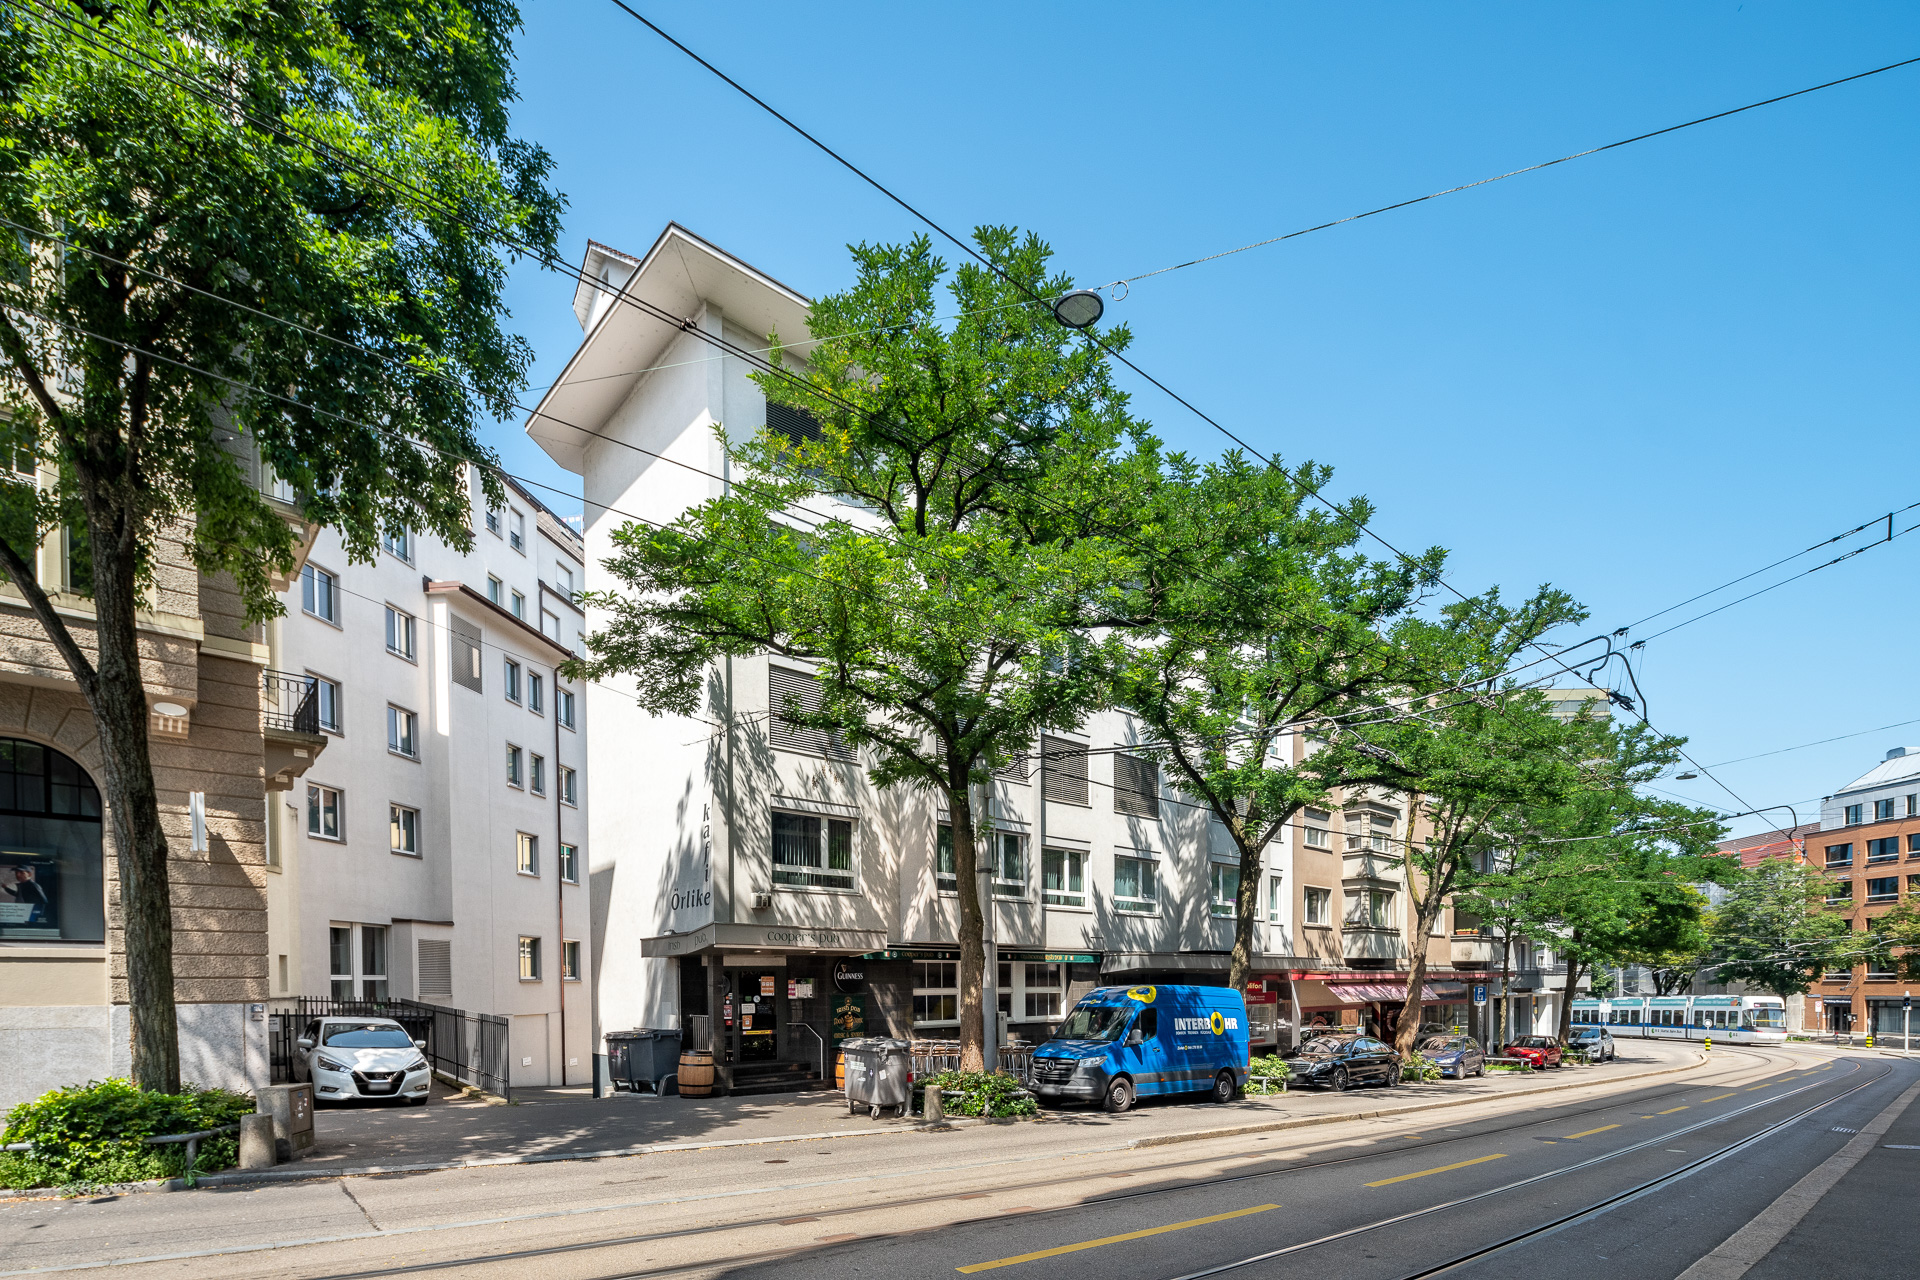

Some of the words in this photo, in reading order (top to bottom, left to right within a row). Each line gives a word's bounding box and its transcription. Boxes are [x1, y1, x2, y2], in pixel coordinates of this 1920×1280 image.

[702, 803, 711, 883] kafi
[671, 888, 711, 911] Örlike
[767, 931, 816, 944] Cooper's
[837, 972, 864, 980] GUINNESS
[1477, 987, 1484, 995] P
[1174, 1011, 1238, 1036] INTERBOHR
